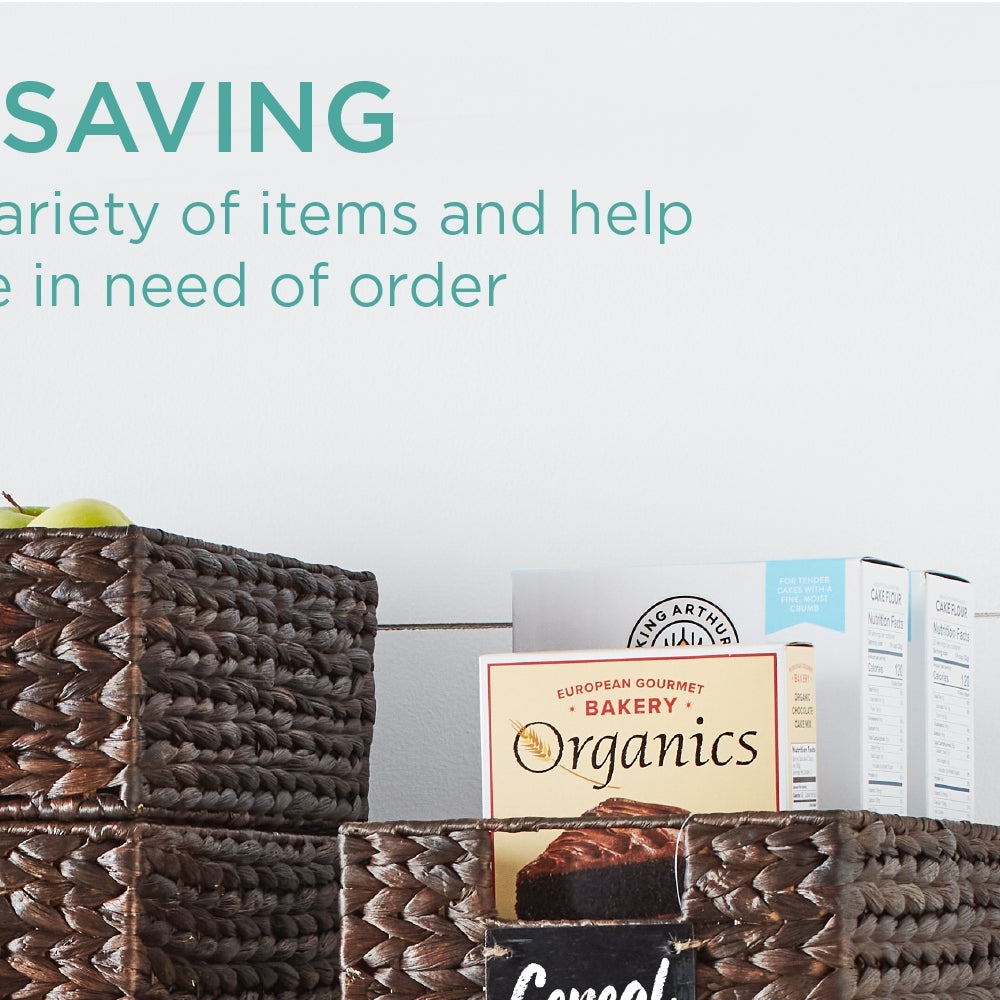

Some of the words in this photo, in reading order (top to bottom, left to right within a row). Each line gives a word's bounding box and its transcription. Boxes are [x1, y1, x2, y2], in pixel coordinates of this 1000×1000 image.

[779, 577, 796, 585] FOR
[798, 576, 830, 584] TENDER
[870, 588, 885, 603] CAKE
[885, 590, 902, 606] FLOUR
[790, 605, 820, 613] CRUMB
[935, 600, 950, 615] CAKE
[951, 603, 968, 619] FLOUR
[635, 610, 667, 648] KING
[672, 603, 732, 645] ARTHUR
[557, 678, 631, 700] EUROPEAN
[635, 678, 705, 695] GOURMET
[585, 697, 678, 716] BAKERY
[513, 716, 758, 790] Organics
